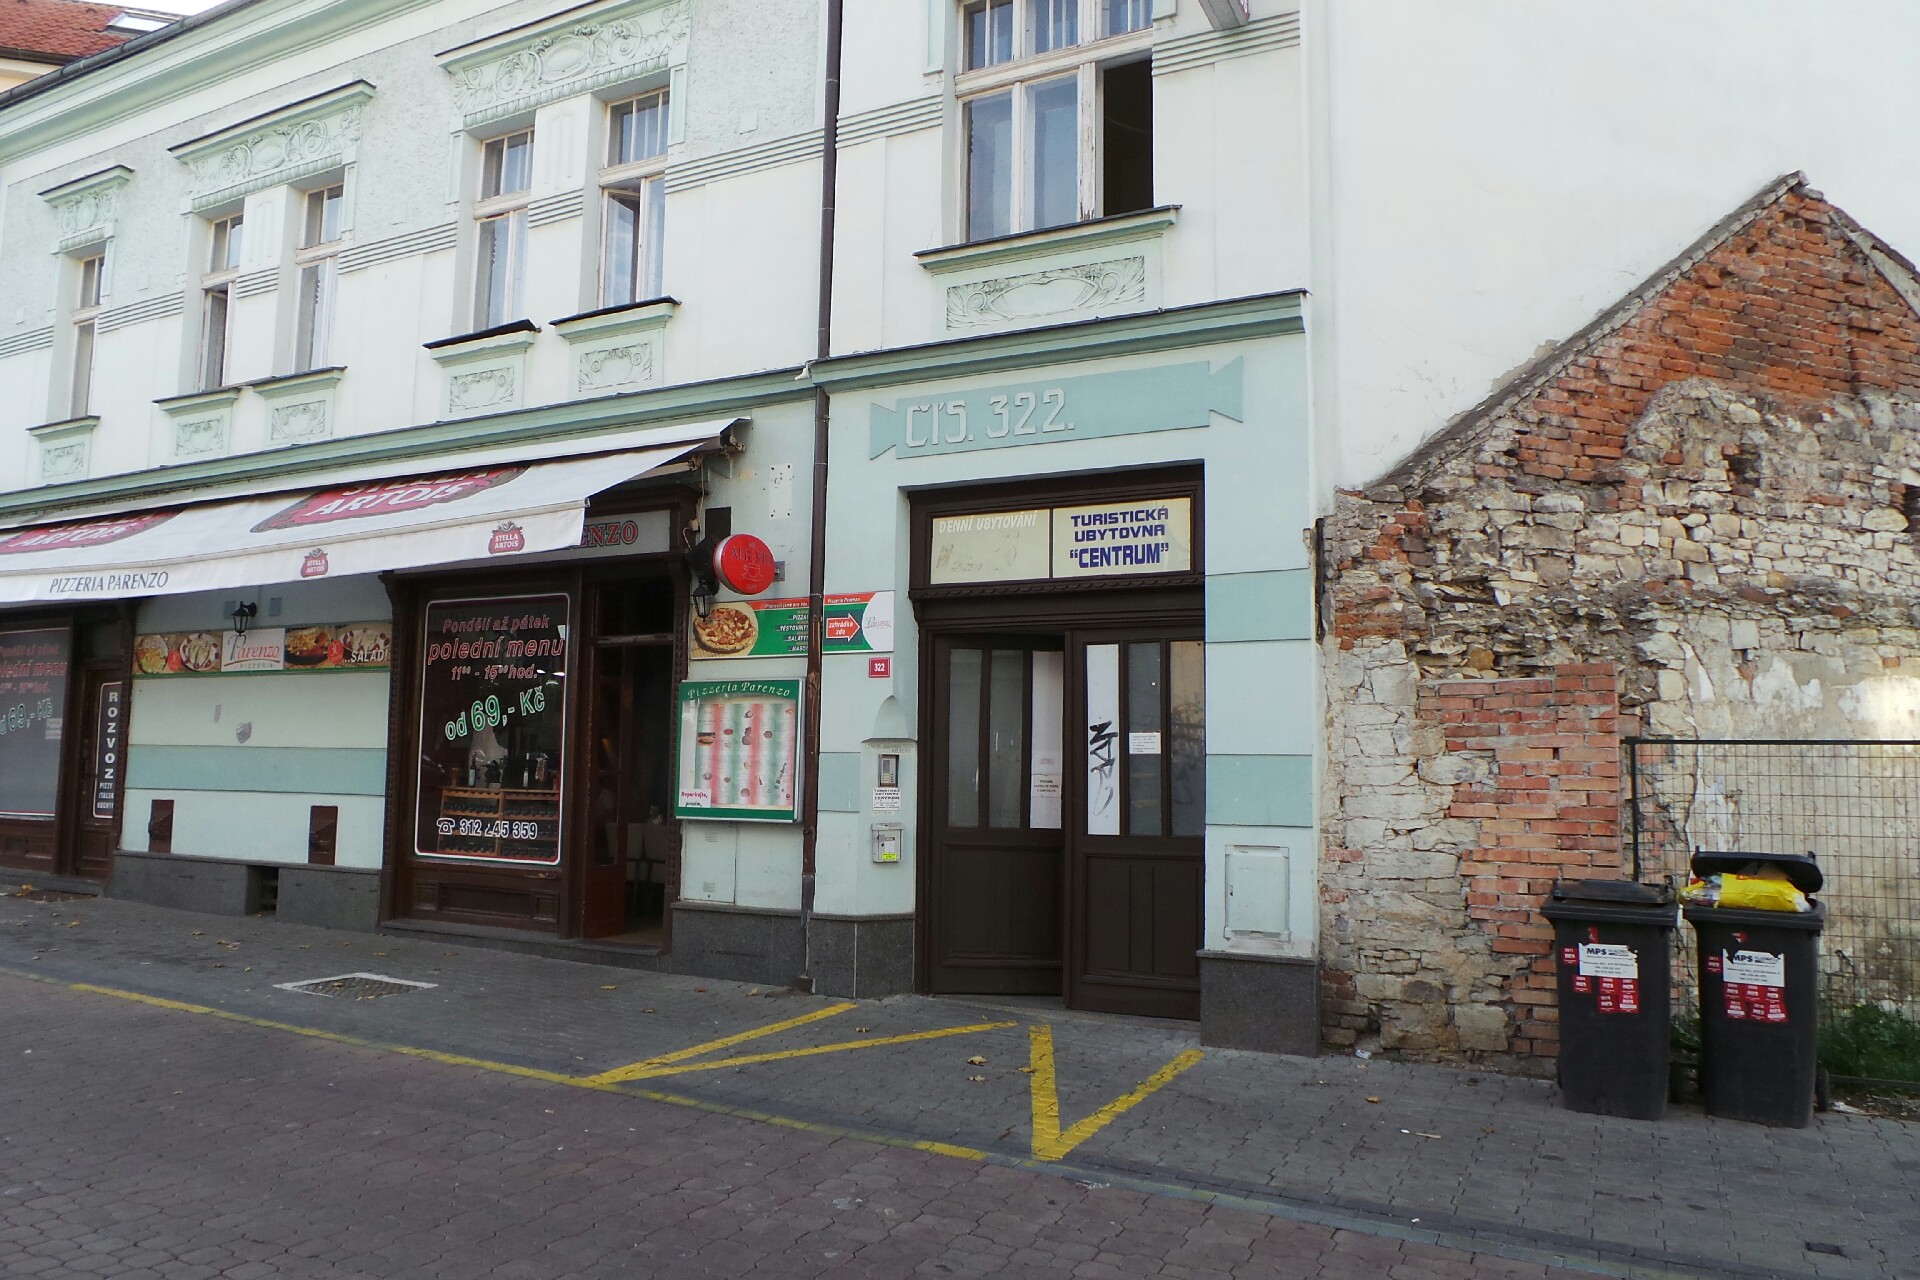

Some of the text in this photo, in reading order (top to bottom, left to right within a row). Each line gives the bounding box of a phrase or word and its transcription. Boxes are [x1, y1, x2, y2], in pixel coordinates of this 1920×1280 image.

[986, 388, 1075, 438] 322.
[302, 481, 474, 517] ARTOIS
[939, 511, 1038, 534] DENNÍ UBYTOVÁNÍ
[1071, 505, 1169, 528] TURISTICKÁ
[495, 533, 518, 543] STELLA
[1074, 524, 1165, 542] UBYTOVNA
[494, 540, 519, 549] ARTOIS
[306, 559, 325, 567] STELLA
[306, 565, 325, 573] ARTOIS
[50, 571, 169, 593] PIZZERIA PARENZO
[443, 614, 551, 633] Pondělí až pátek
[227, 634, 280, 661] Parenzo
[428, 636, 564, 666] polední menu
[508, 664, 538, 679] hod.
[873, 662, 885, 672] 322
[687, 681, 790, 700] Pizzeria Parenzo
[445, 686, 546, 741] od 69,- Kč
[104, 692, 118, 779] ROZVOZ
[459, 819, 482, 836] 312
[512, 821, 538, 840] 359
